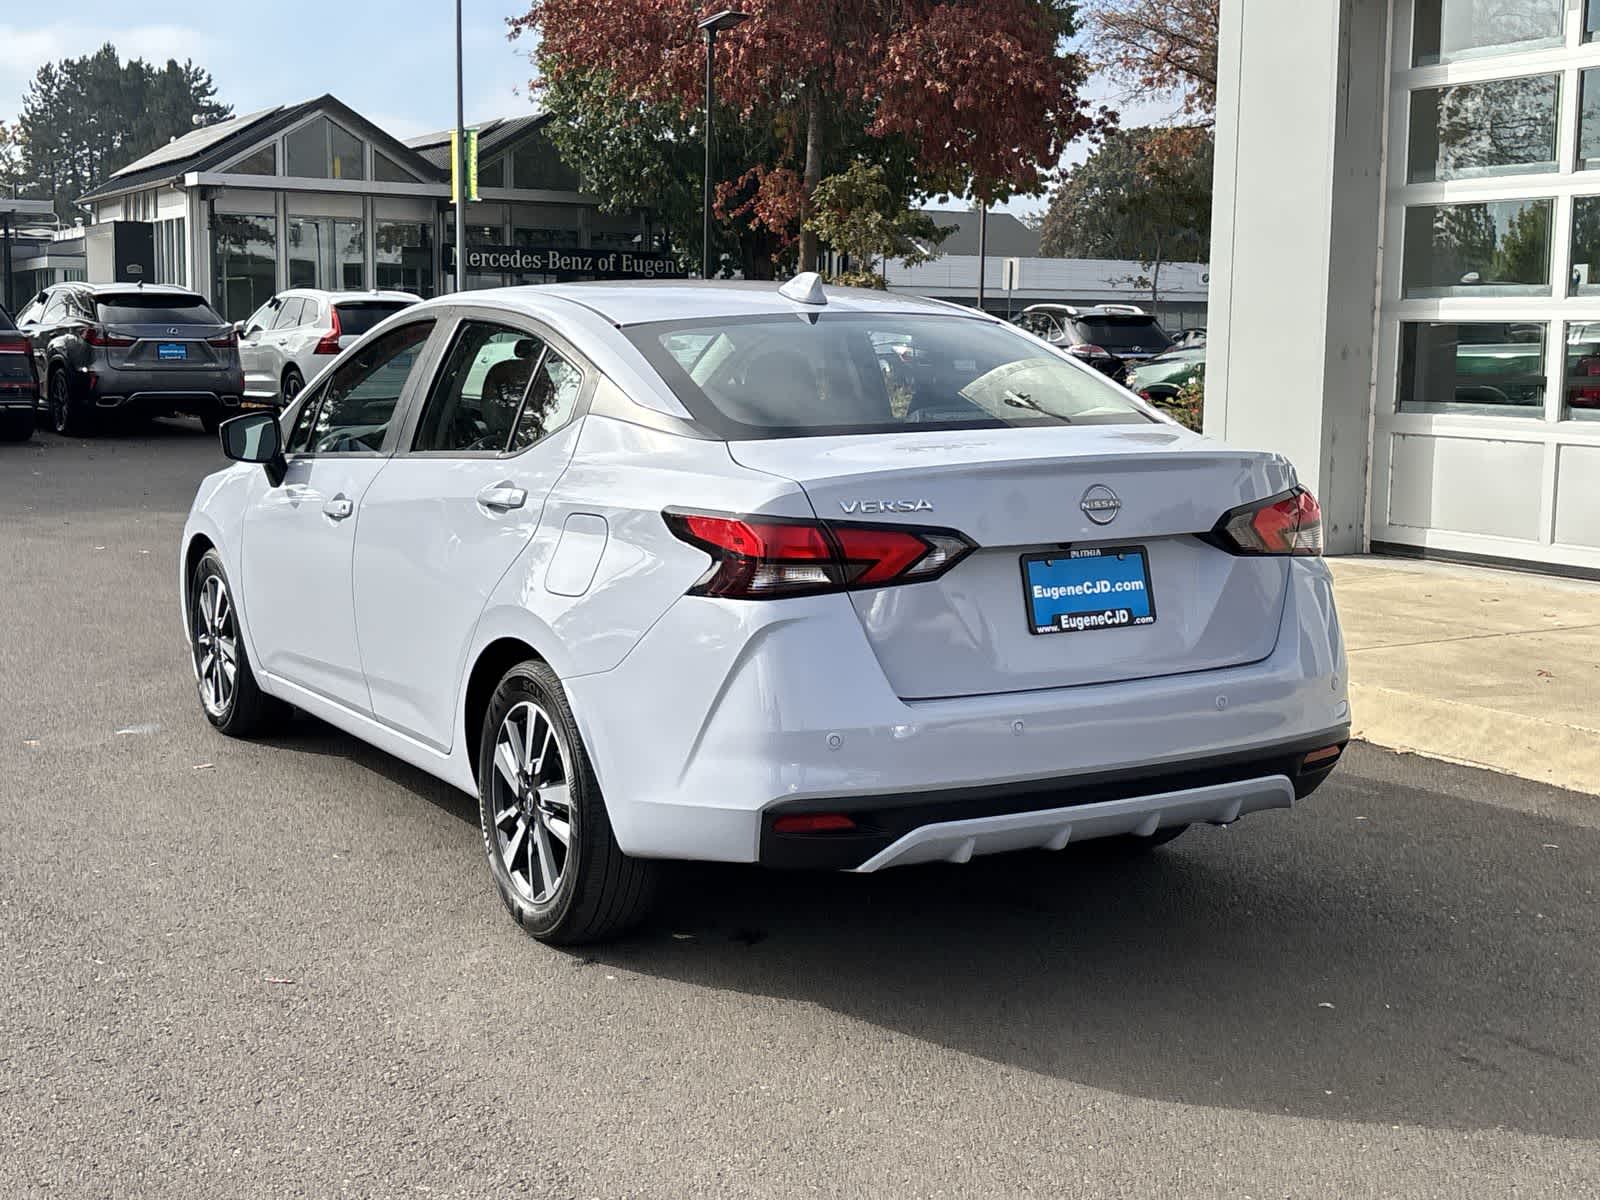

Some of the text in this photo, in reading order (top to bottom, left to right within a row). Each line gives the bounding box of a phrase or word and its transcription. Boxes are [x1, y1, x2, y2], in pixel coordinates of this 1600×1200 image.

[598, 253, 616, 272] of
[839, 498, 934, 513] VERSA
[1080, 499, 1121, 510] NISSAN
[1033, 580, 1144, 599] EugeneCJD.com
[1060, 609, 1128, 630] EugeneCJD
